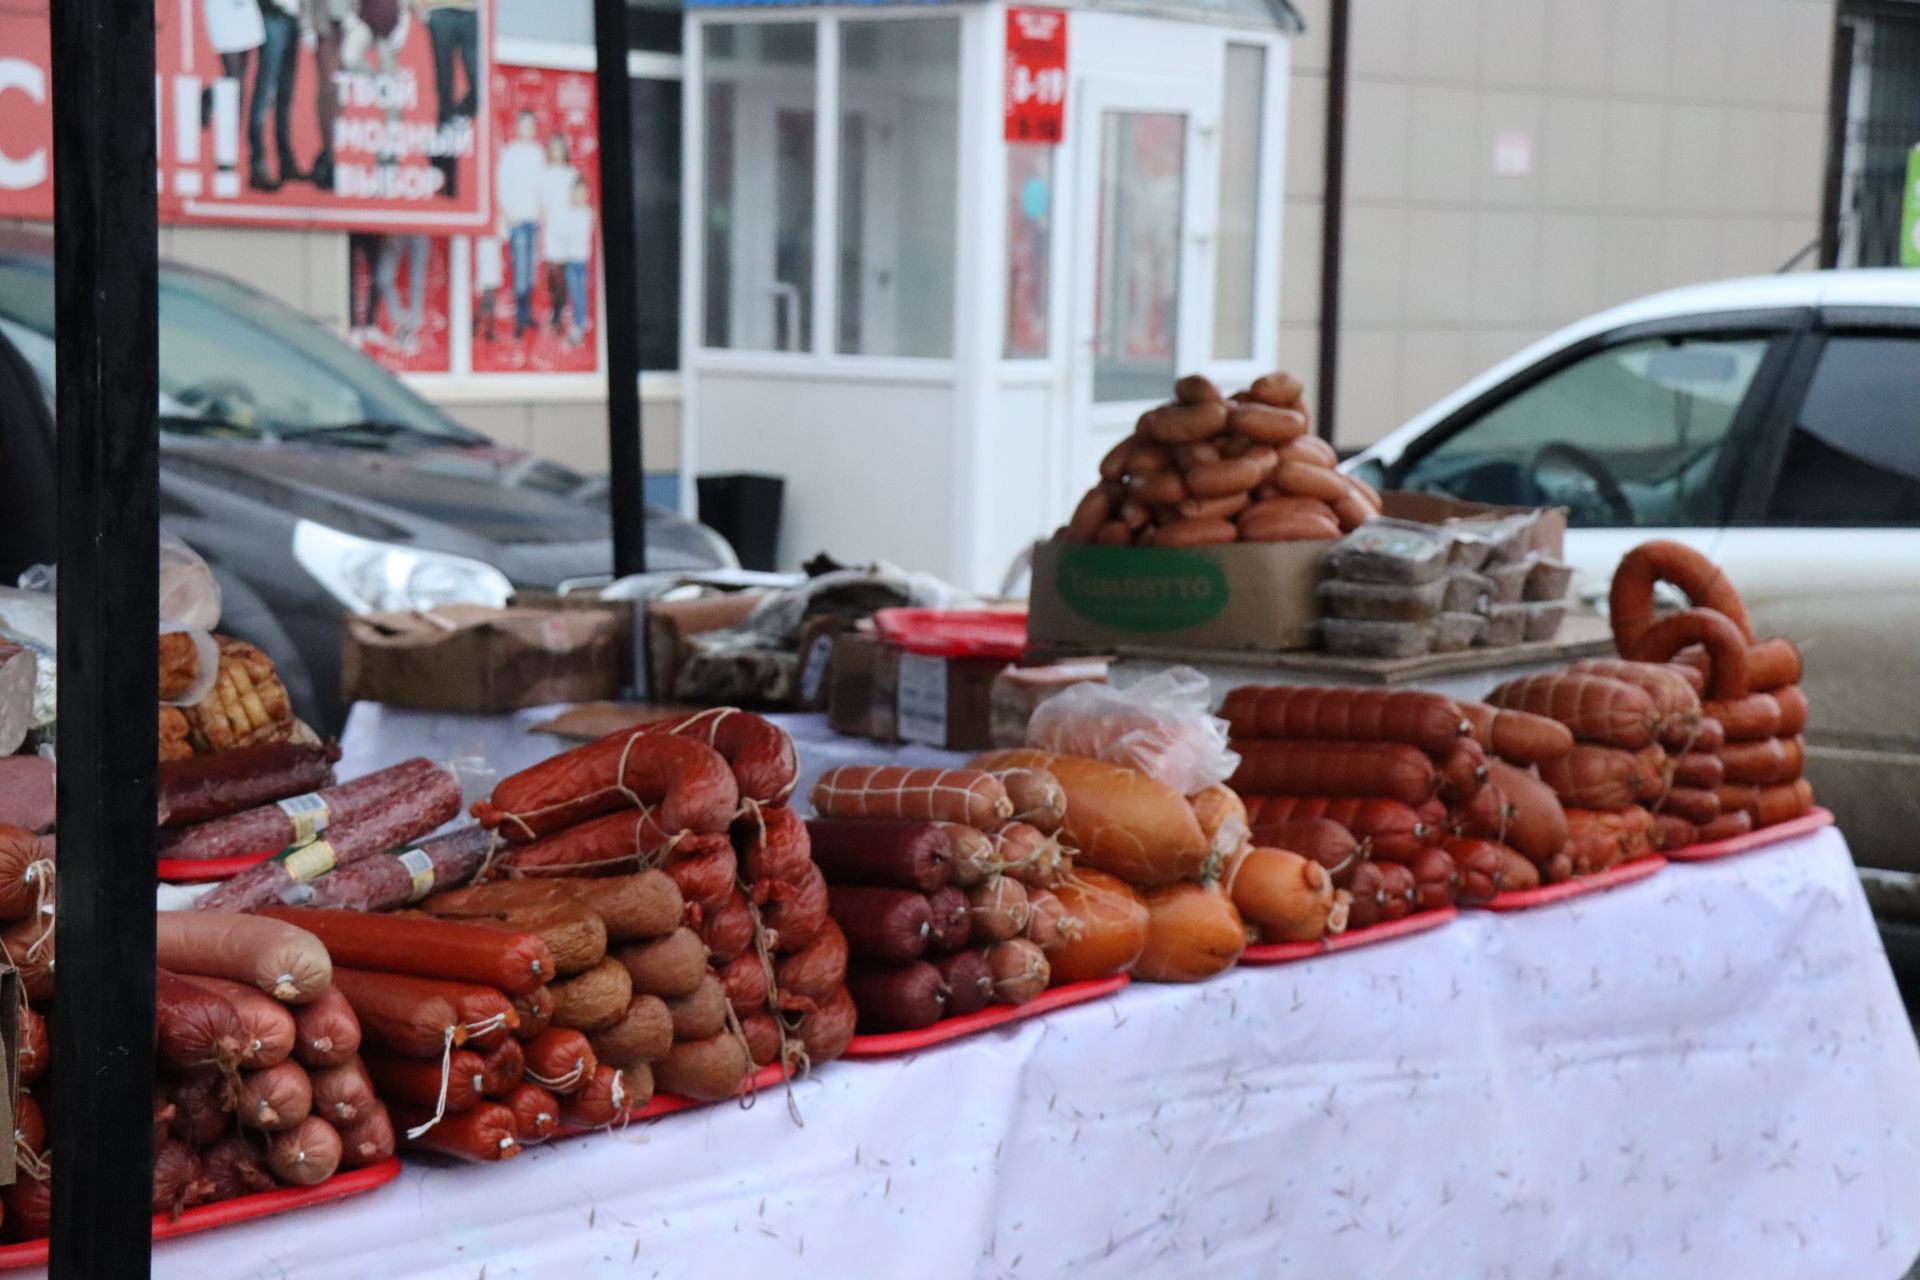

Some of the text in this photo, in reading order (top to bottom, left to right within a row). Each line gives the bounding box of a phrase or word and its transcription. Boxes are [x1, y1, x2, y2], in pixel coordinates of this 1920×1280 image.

[333, 67, 418, 109] ТВОЙ
[334, 115, 475, 158] МОДНЫЙ
[334, 163, 445, 199] ВЫБОР
